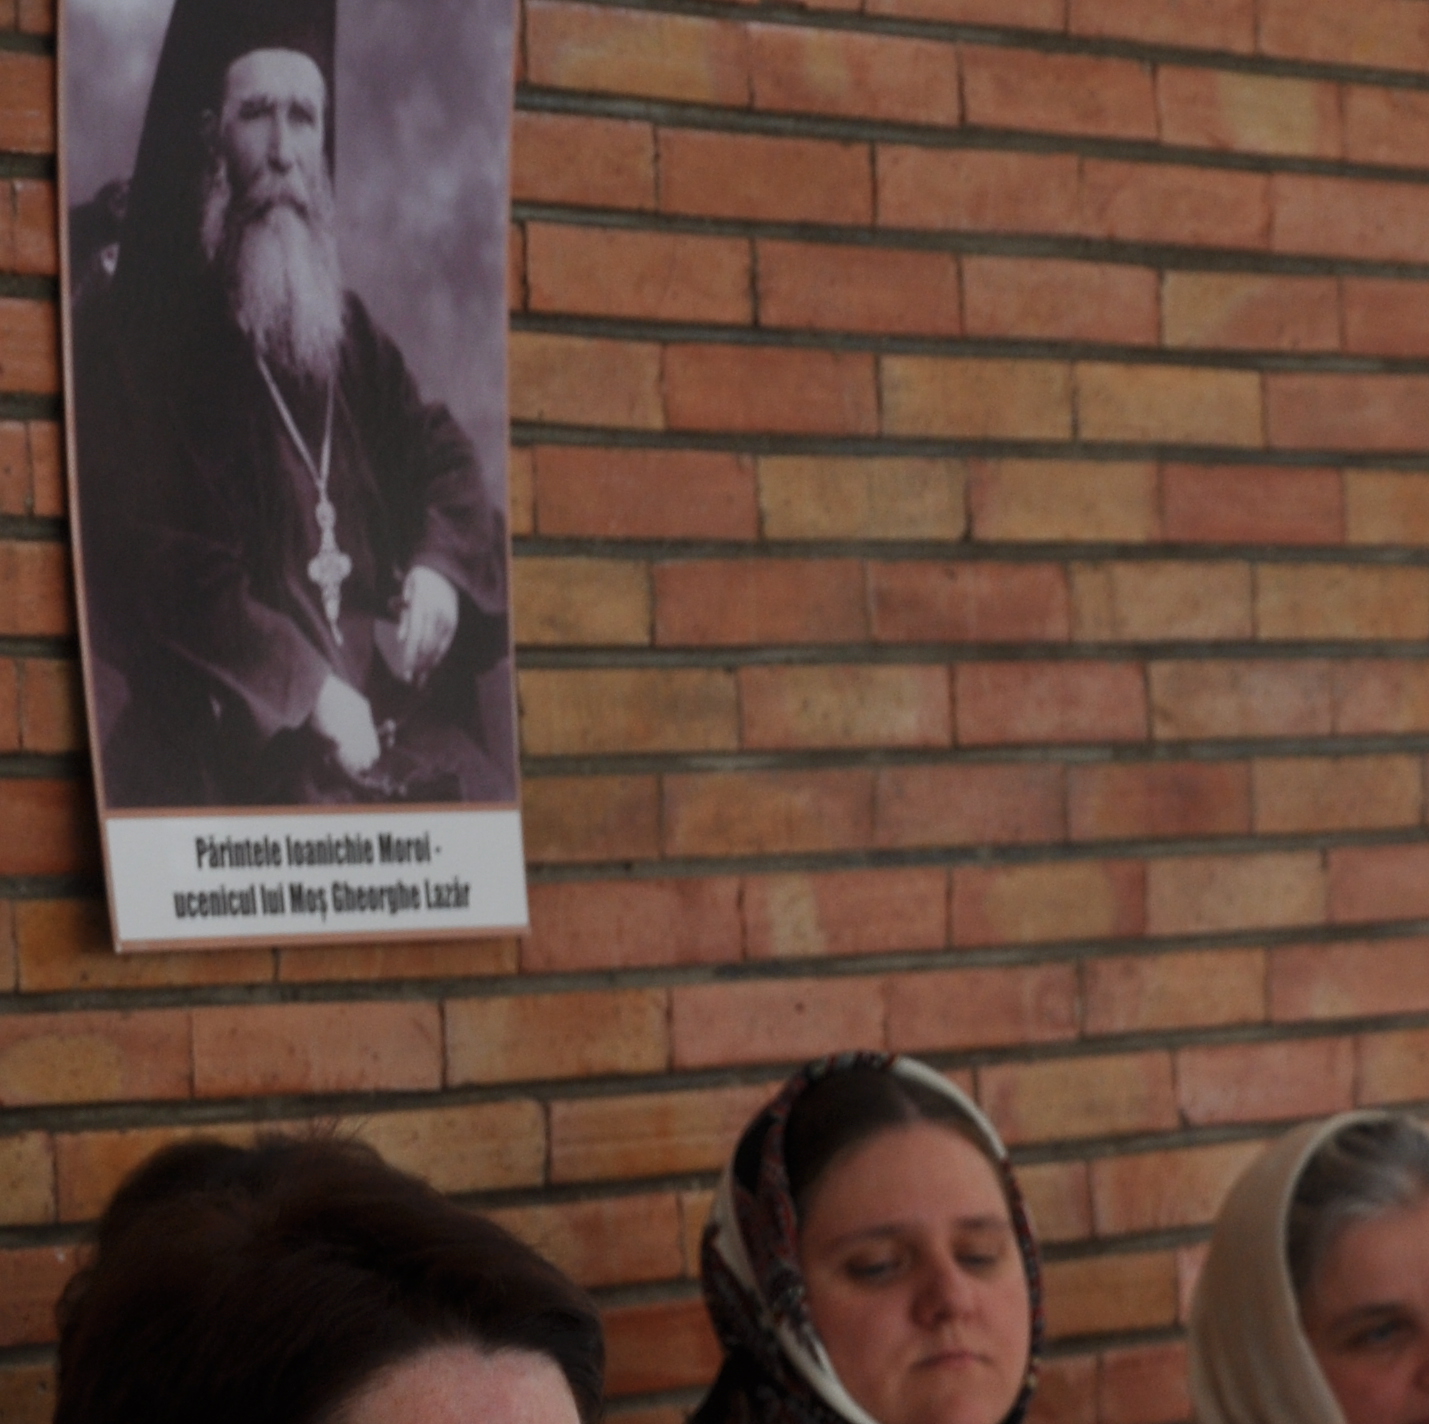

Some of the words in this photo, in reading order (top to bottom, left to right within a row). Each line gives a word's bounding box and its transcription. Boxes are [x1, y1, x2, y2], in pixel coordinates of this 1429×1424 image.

[285, 833, 375, 867] Ioanichie
[173, 884, 257, 920] ucenicul
[259, 882, 286, 916] lui
[331, 880, 421, 916] Gheorghe
